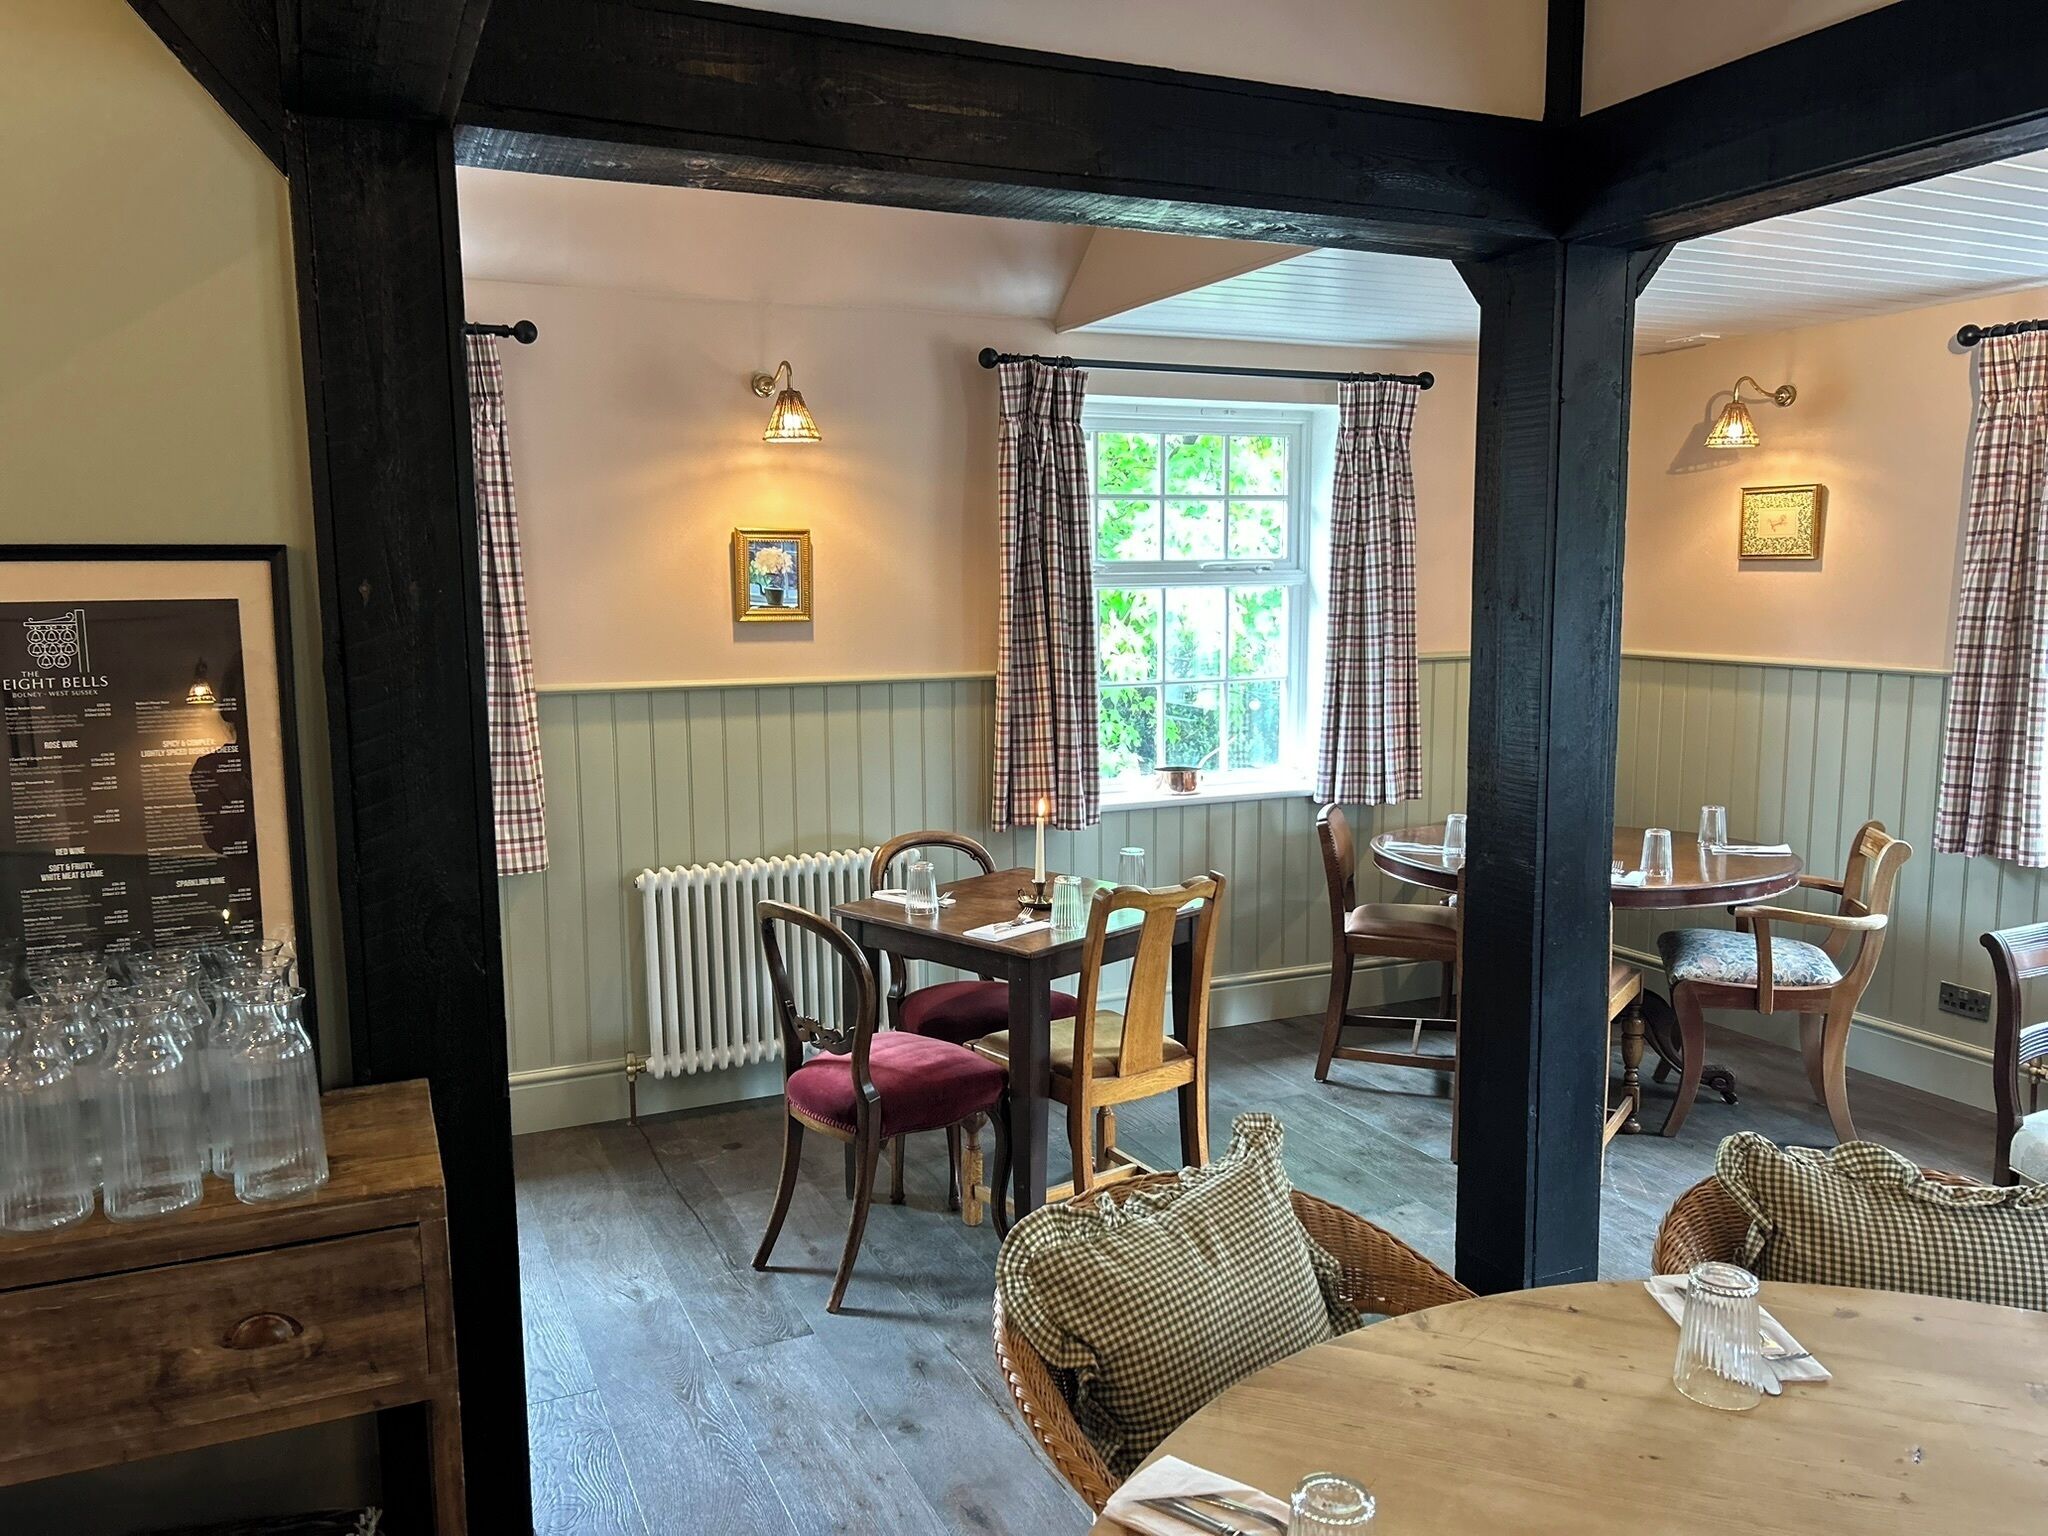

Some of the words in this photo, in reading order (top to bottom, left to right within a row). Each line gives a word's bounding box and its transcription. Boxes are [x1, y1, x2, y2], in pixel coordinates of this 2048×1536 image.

[3, 678, 55, 691] EIGHT
[62, 675, 109, 689] BELLS
[12, 691, 42, 699] BOLNEY
[71, 689, 99, 697] SUSSEX
[48, 863, 65, 872] SOFT
